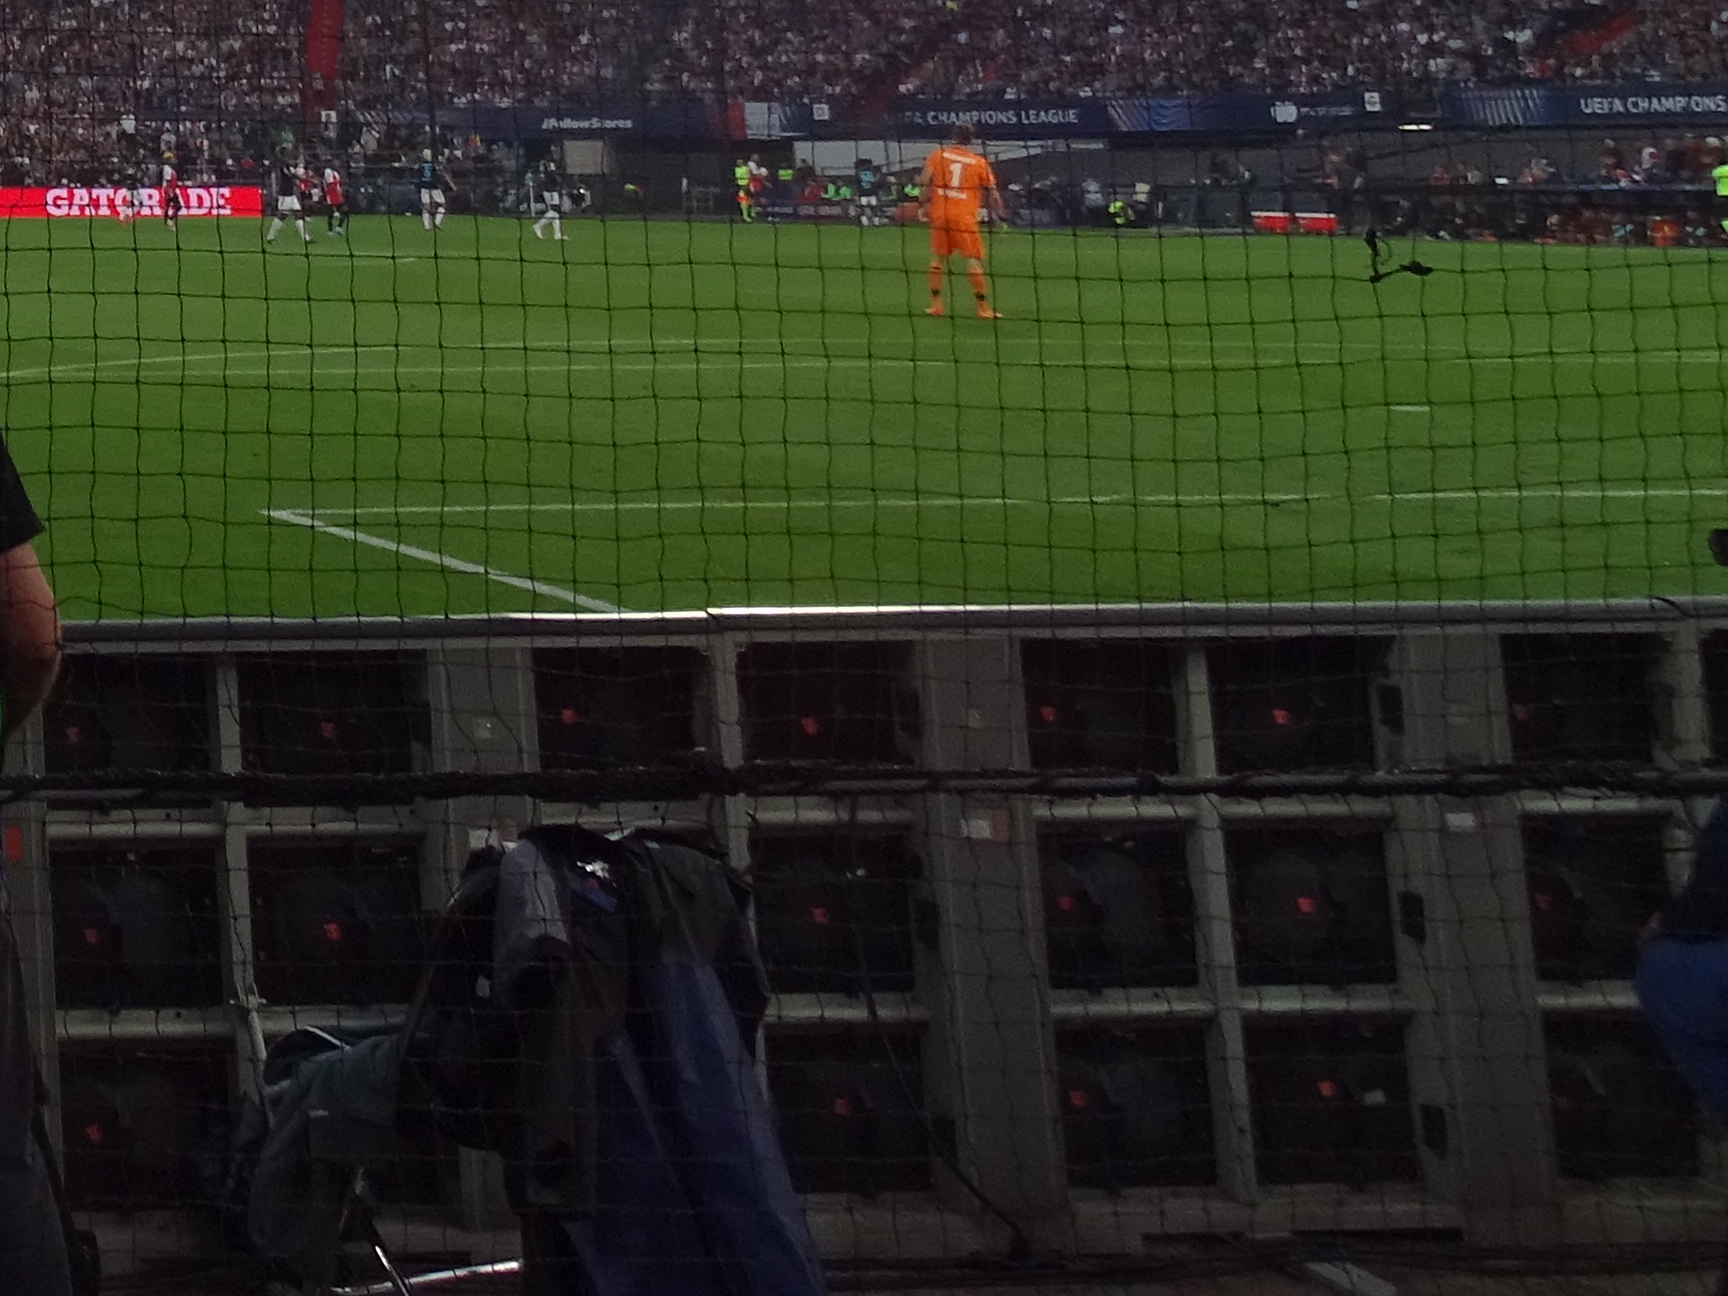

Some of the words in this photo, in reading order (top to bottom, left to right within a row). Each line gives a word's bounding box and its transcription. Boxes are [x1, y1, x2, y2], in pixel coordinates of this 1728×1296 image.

[1580, 97, 1625, 113] UEFA
[927, 110, 1017, 126] CHAMPIONS
[1021, 109, 1078, 124] LEAGUE
[948, 163, 963, 188] 1
[46, 187, 232, 217] GATORADE
